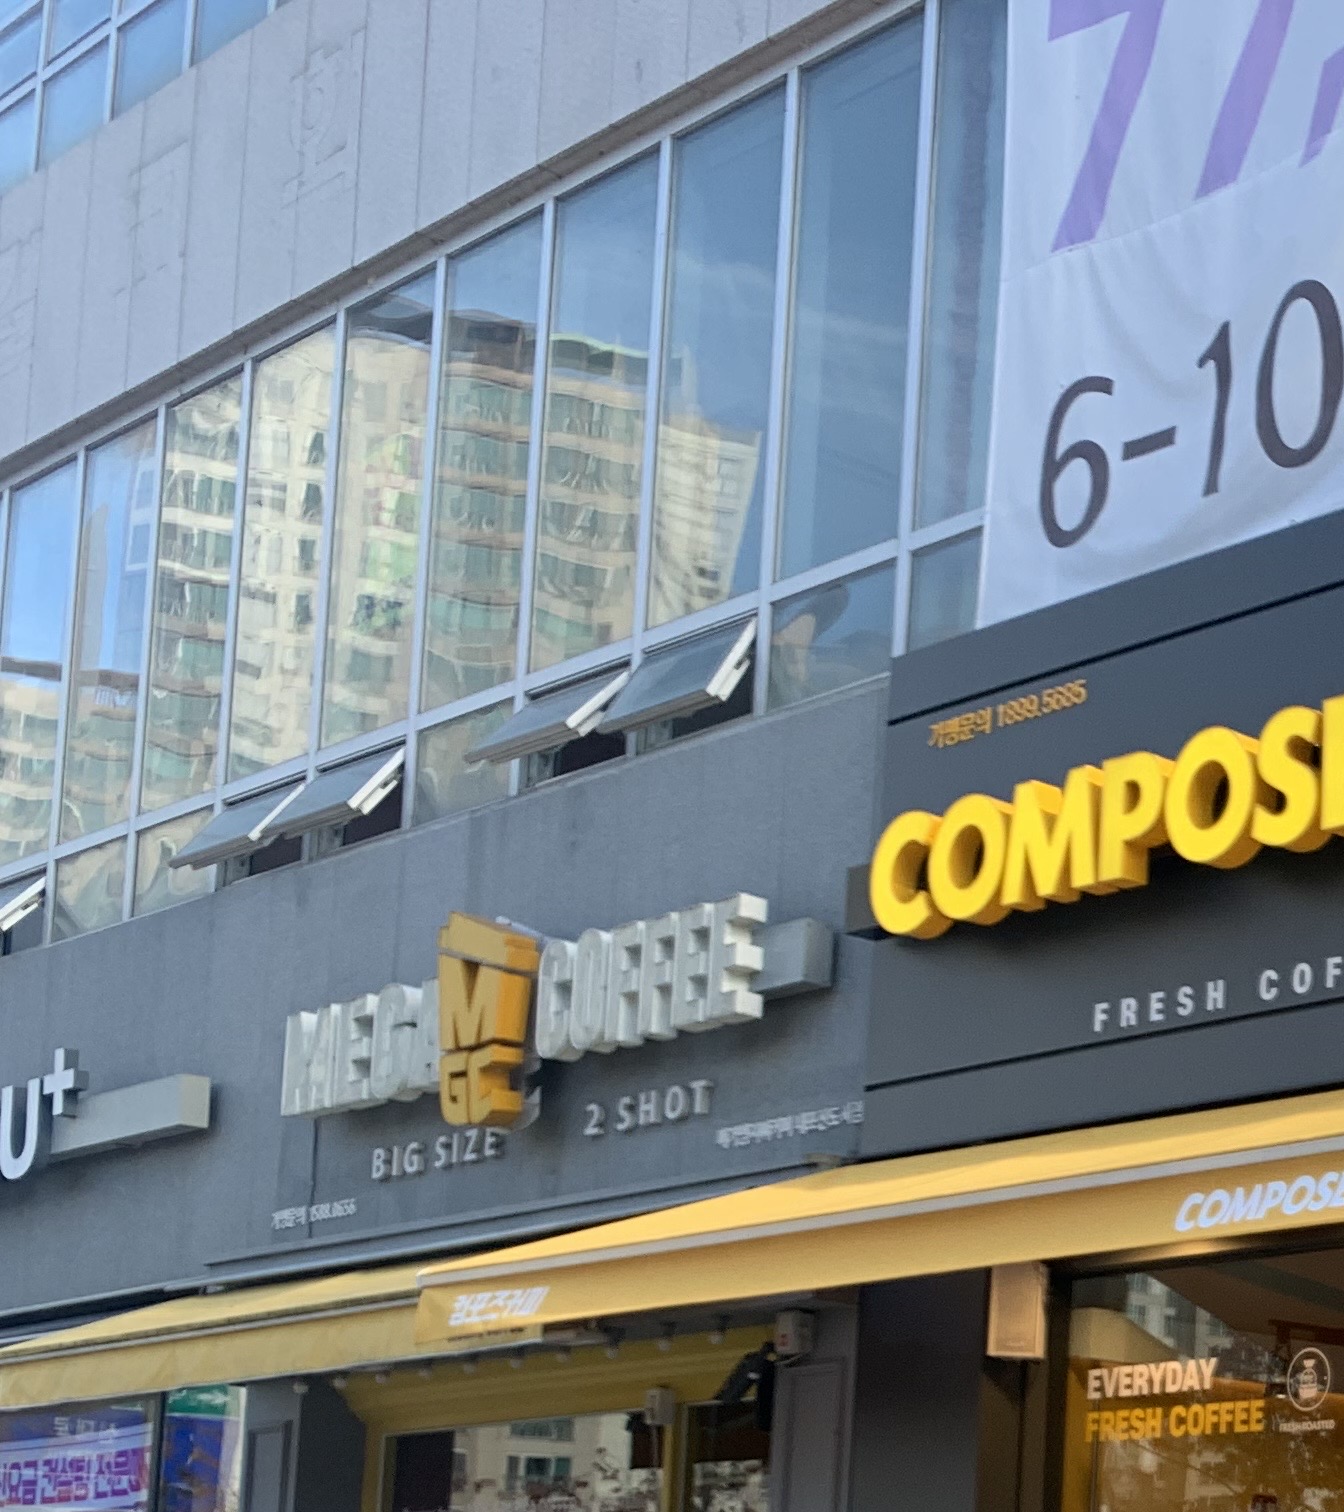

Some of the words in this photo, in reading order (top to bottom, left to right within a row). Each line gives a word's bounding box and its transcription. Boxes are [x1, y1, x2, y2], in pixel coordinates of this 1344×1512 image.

[281, 977, 441, 1117] MEGA
[536, 891, 768, 1062] COFFEE
[1091, 979, 1228, 1033] FRESH
[582, 1103, 606, 1136] 2
[615, 1078, 714, 1132] SHOT
[370, 1142, 423, 1181] BIG
[433, 1126, 509, 1169] SIZE
[1087, 1358, 1218, 1401] EVERYDAY
[1085, 1408, 1162, 1443] FRESH
[1169, 1399, 1265, 1437] COFFEE
